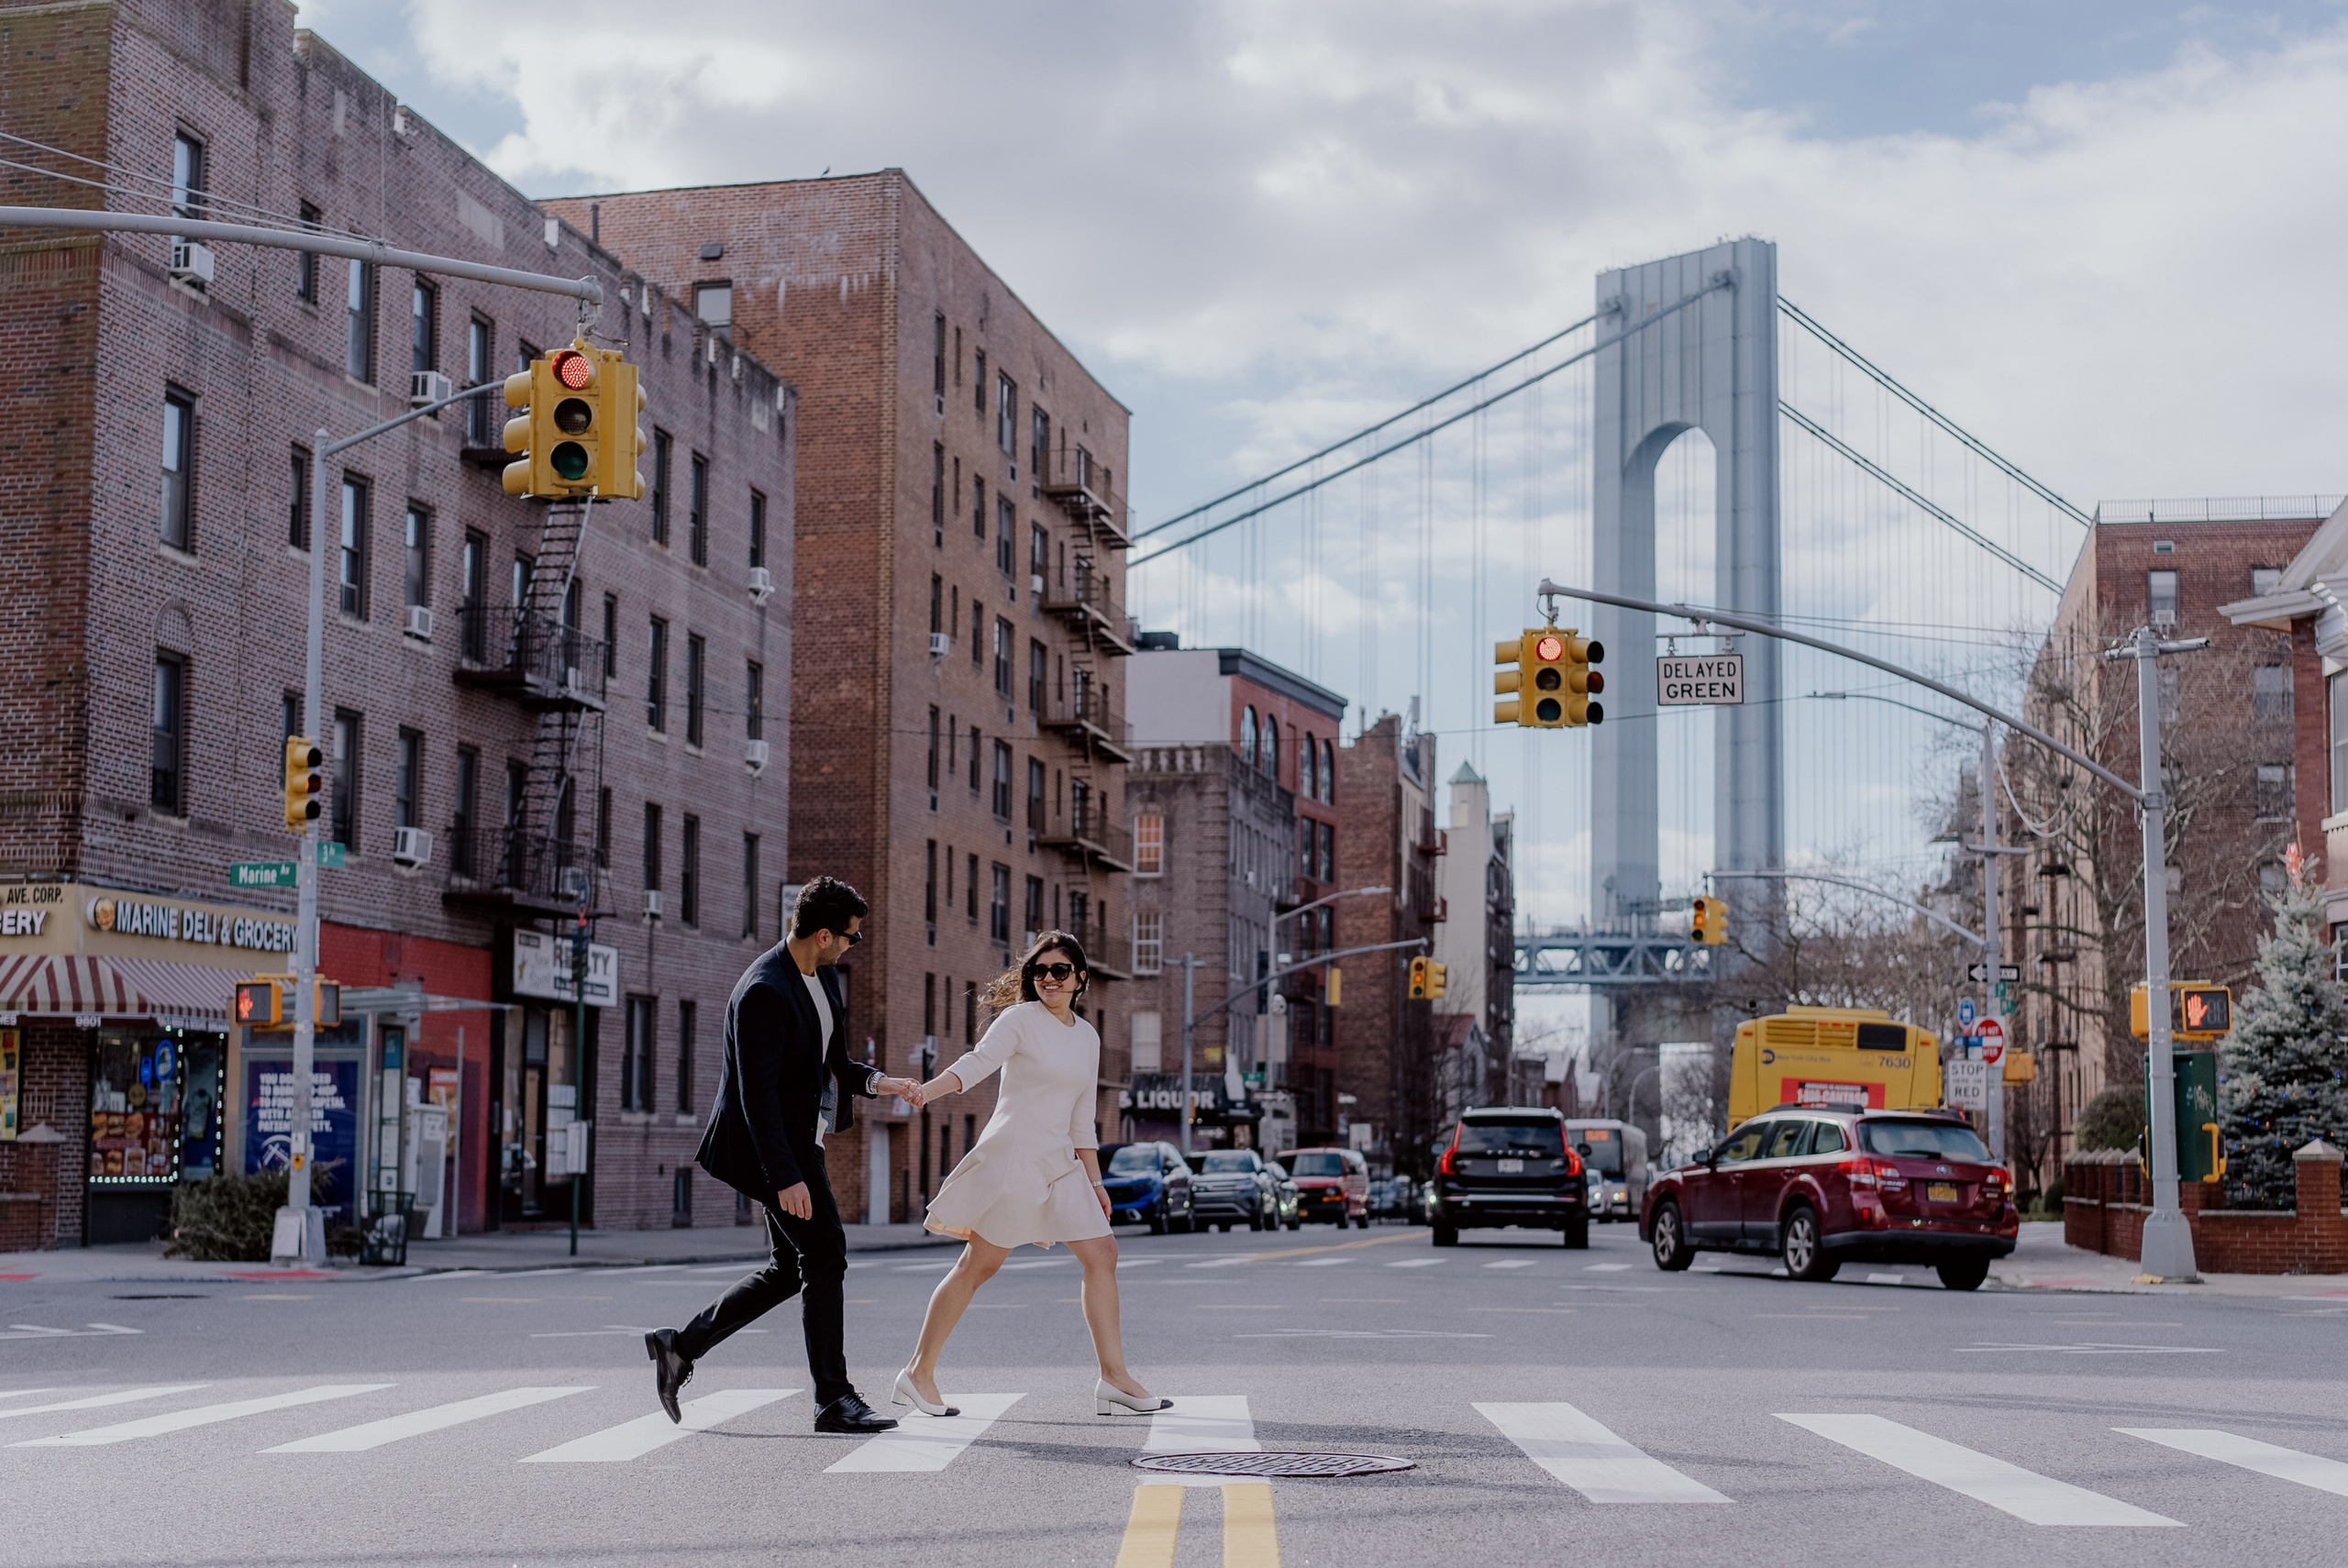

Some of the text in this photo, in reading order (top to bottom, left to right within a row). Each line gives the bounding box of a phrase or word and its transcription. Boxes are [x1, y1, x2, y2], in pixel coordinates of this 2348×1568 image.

[1664, 662, 1736, 679] DELAYED
[1667, 682, 1735, 699] GREEN
[238, 864, 290, 884] Marine Av
[7, 887, 63, 904] AVE. CORP.
[0, 910, 47, 935] ERY
[116, 900, 300, 954] MARINE DELI & GROCERY
[553, 944, 610, 975] RETY
[75, 1015, 102, 1027] 9801
[1878, 1055, 1911, 1069] 7630
[1951, 1064, 1983, 1076] STOP
[1955, 1087, 1979, 1098] RED
